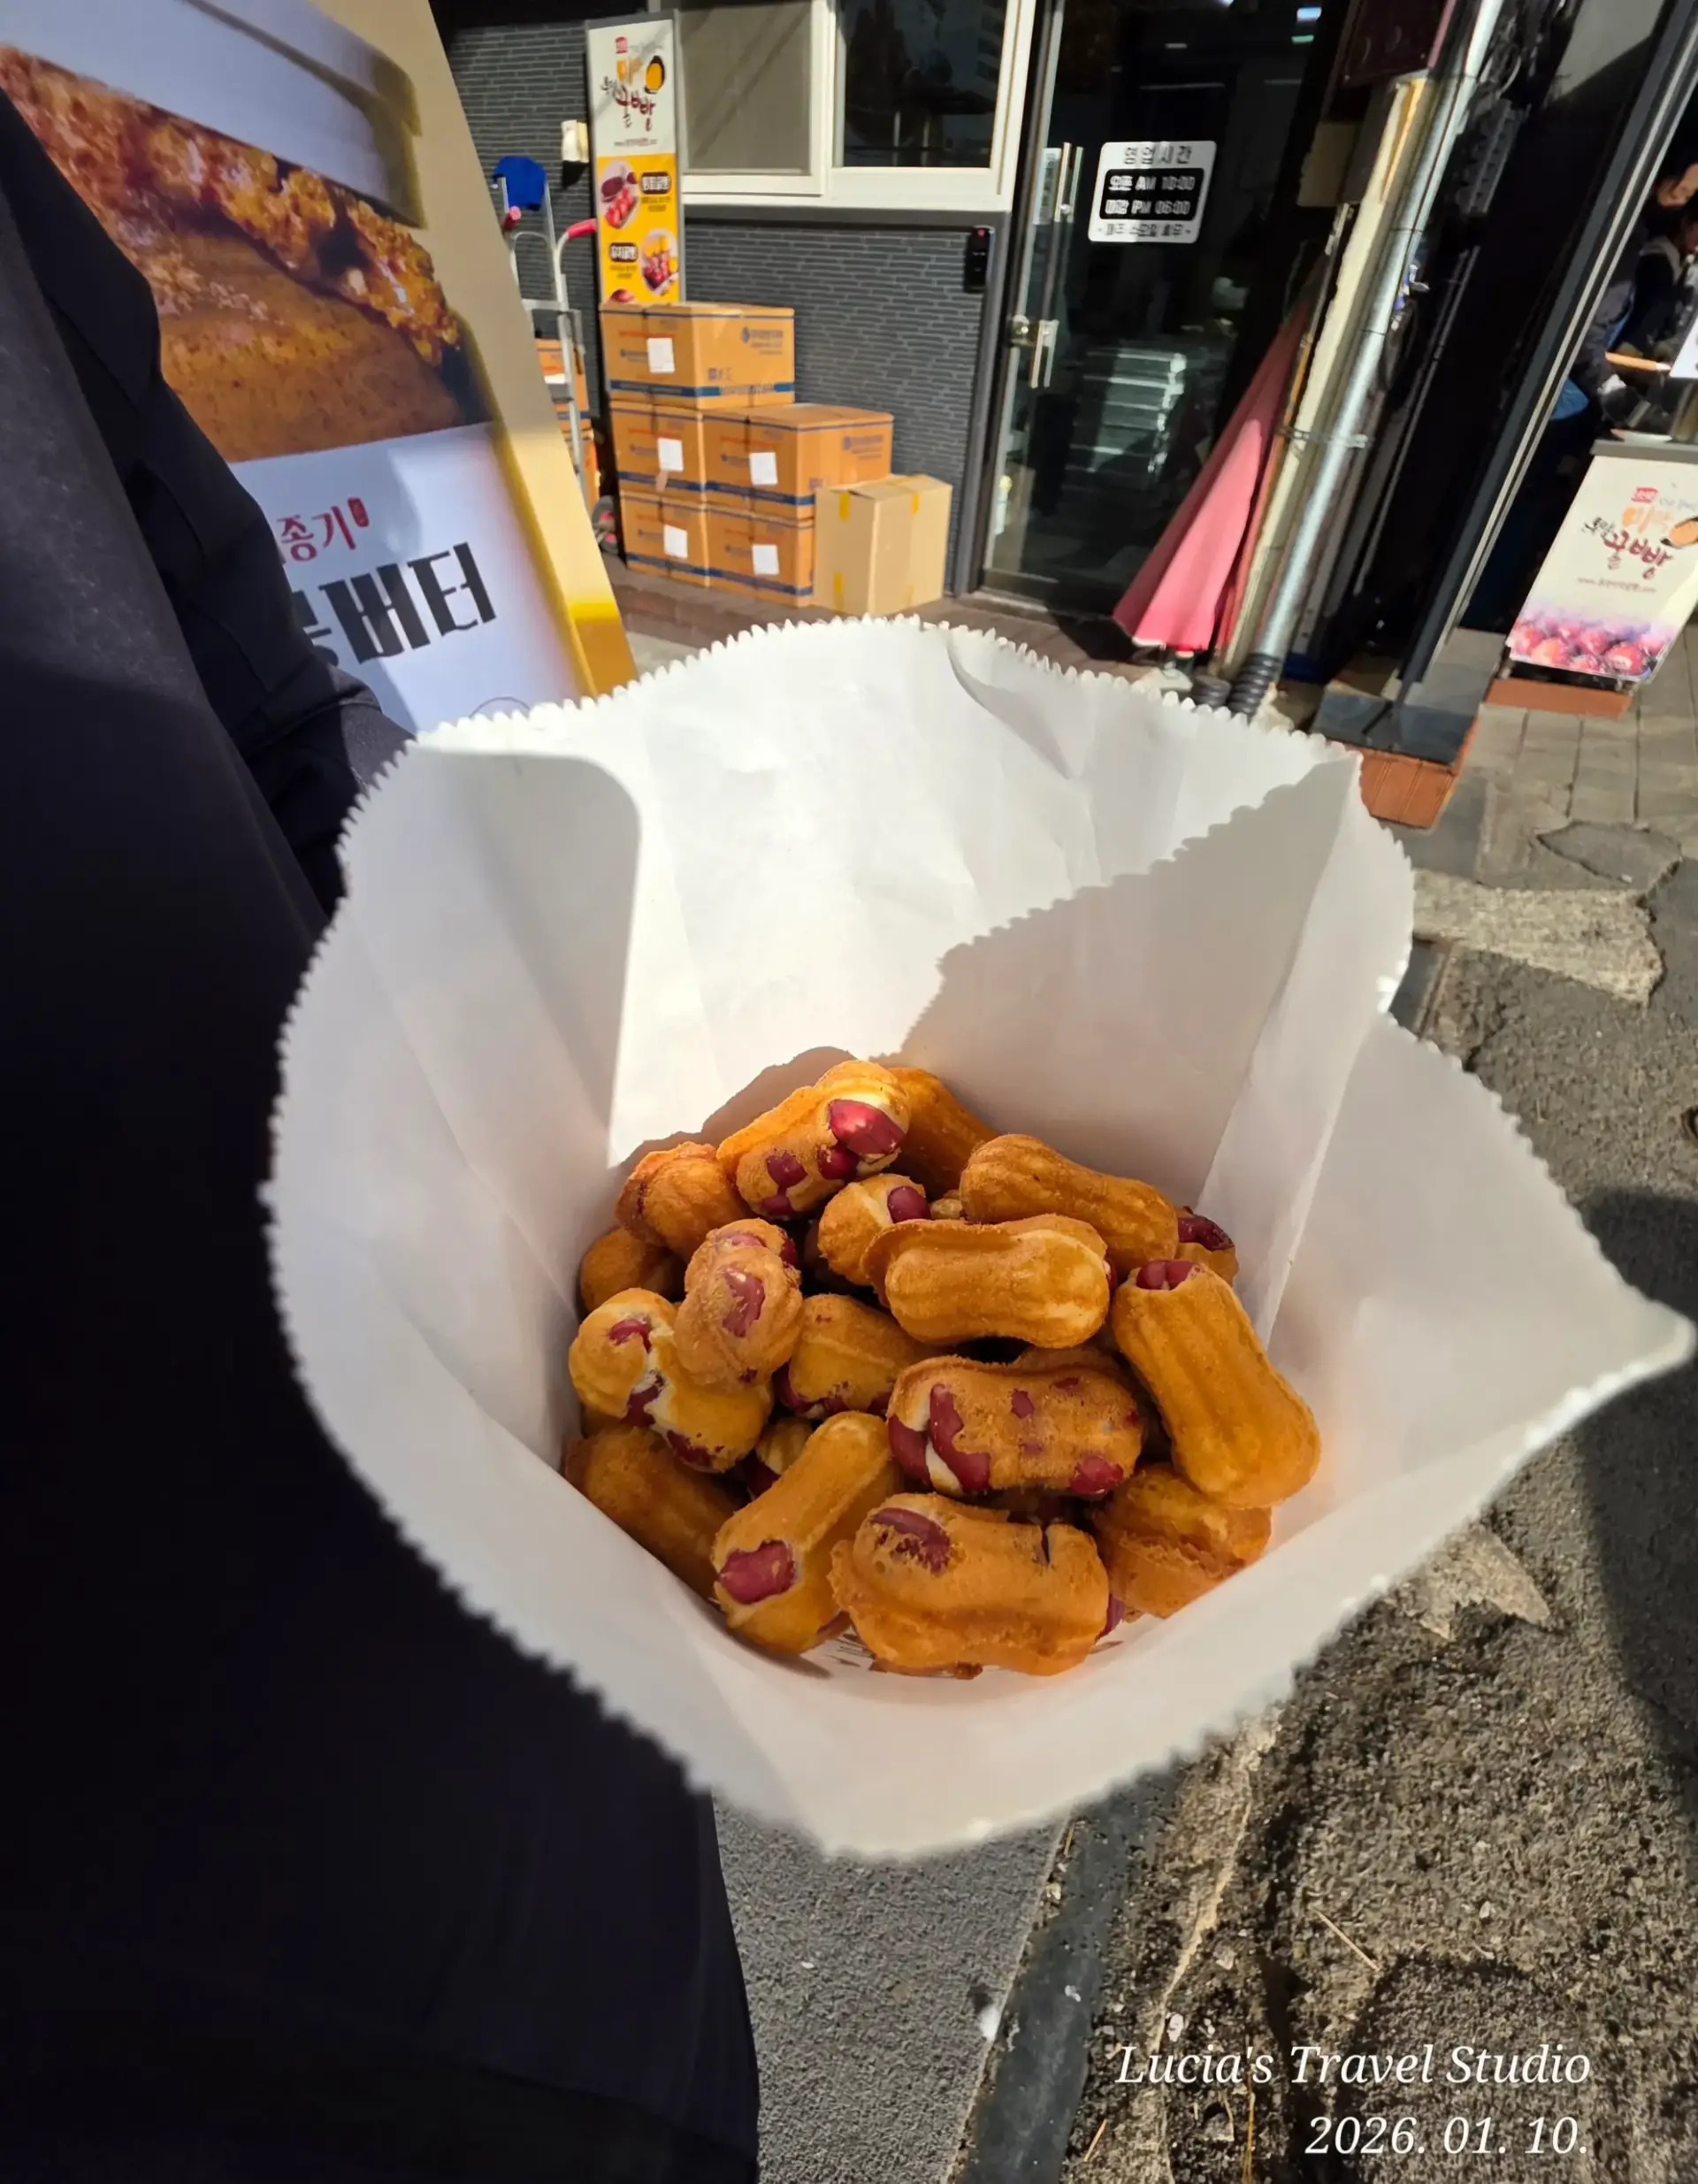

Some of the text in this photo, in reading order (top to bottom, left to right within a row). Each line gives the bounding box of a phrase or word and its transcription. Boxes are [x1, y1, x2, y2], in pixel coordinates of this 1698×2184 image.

[1124, 146, 1192, 165] 영업시간
[1108, 175, 1133, 191] 오픈
[1135, 176, 1157, 190] AM
[1105, 199, 1190, 215] 마감 PM 06:00
